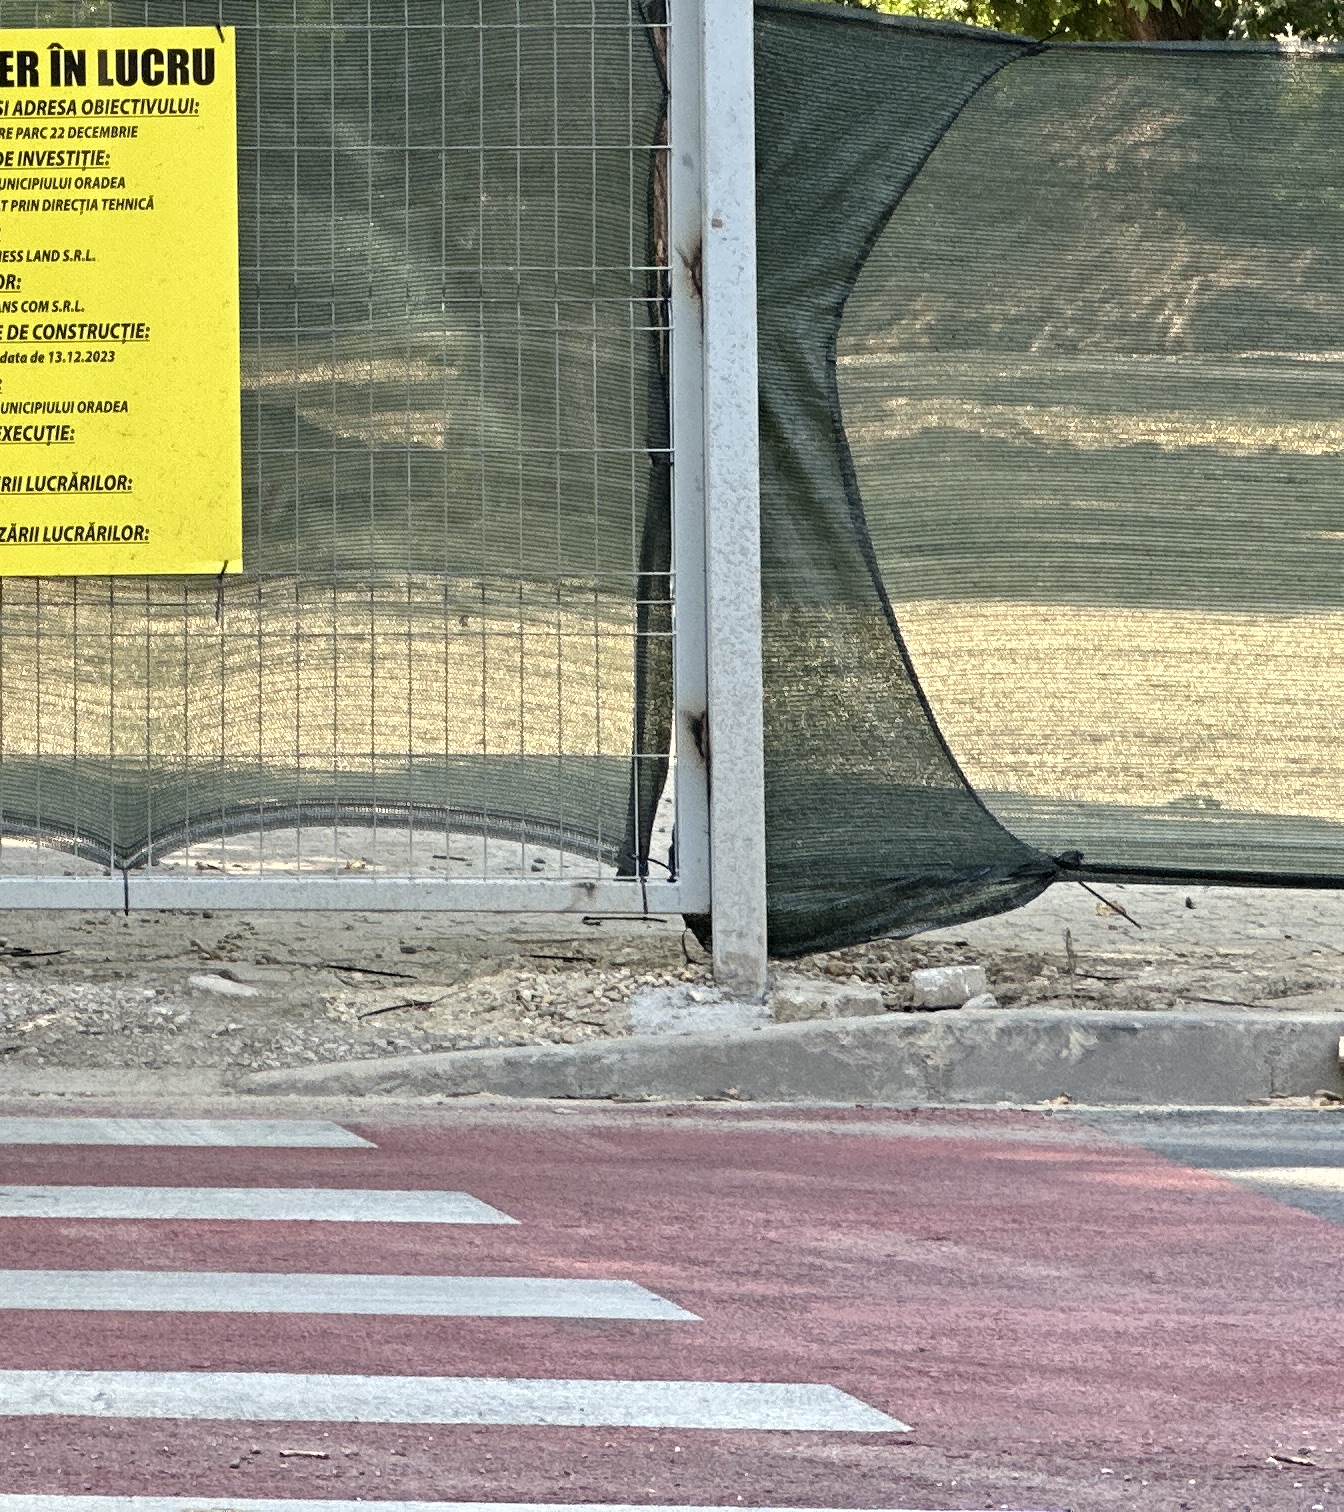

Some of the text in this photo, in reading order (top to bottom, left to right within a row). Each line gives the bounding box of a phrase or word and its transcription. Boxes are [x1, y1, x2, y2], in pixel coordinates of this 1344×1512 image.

[47, 42, 86, 87] ÎN
[97, 47, 216, 86] LUCRU
[12, 100, 76, 116] ADRESA
[81, 98, 199, 115] OBIECTIVULUI:
[16, 127, 48, 140] PARC
[50, 127, 65, 140] 22
[67, 126, 138, 139] DECEMBRIE
[75, 177, 125, 189] ORADEA
[11, 200, 40, 212] PRIN
[102, 195, 154, 211] TEHNICĂ
[26, 250, 60, 262] LAND
[63, 249, 95, 262] S.R.L.
[21, 301, 48, 313] COM
[51, 300, 85, 313] S.R.L.
[7, 325, 29, 340] DE
[0, 351, 27, 363] data
[30, 351, 45, 363] de
[48, 351, 115, 363] 13.12.2023
[77, 401, 128, 414] ORADEA
[26, 471, 132, 491] LUCRĂRILOR:
[43, 522, 149, 542] LUCRĂRILOR:
